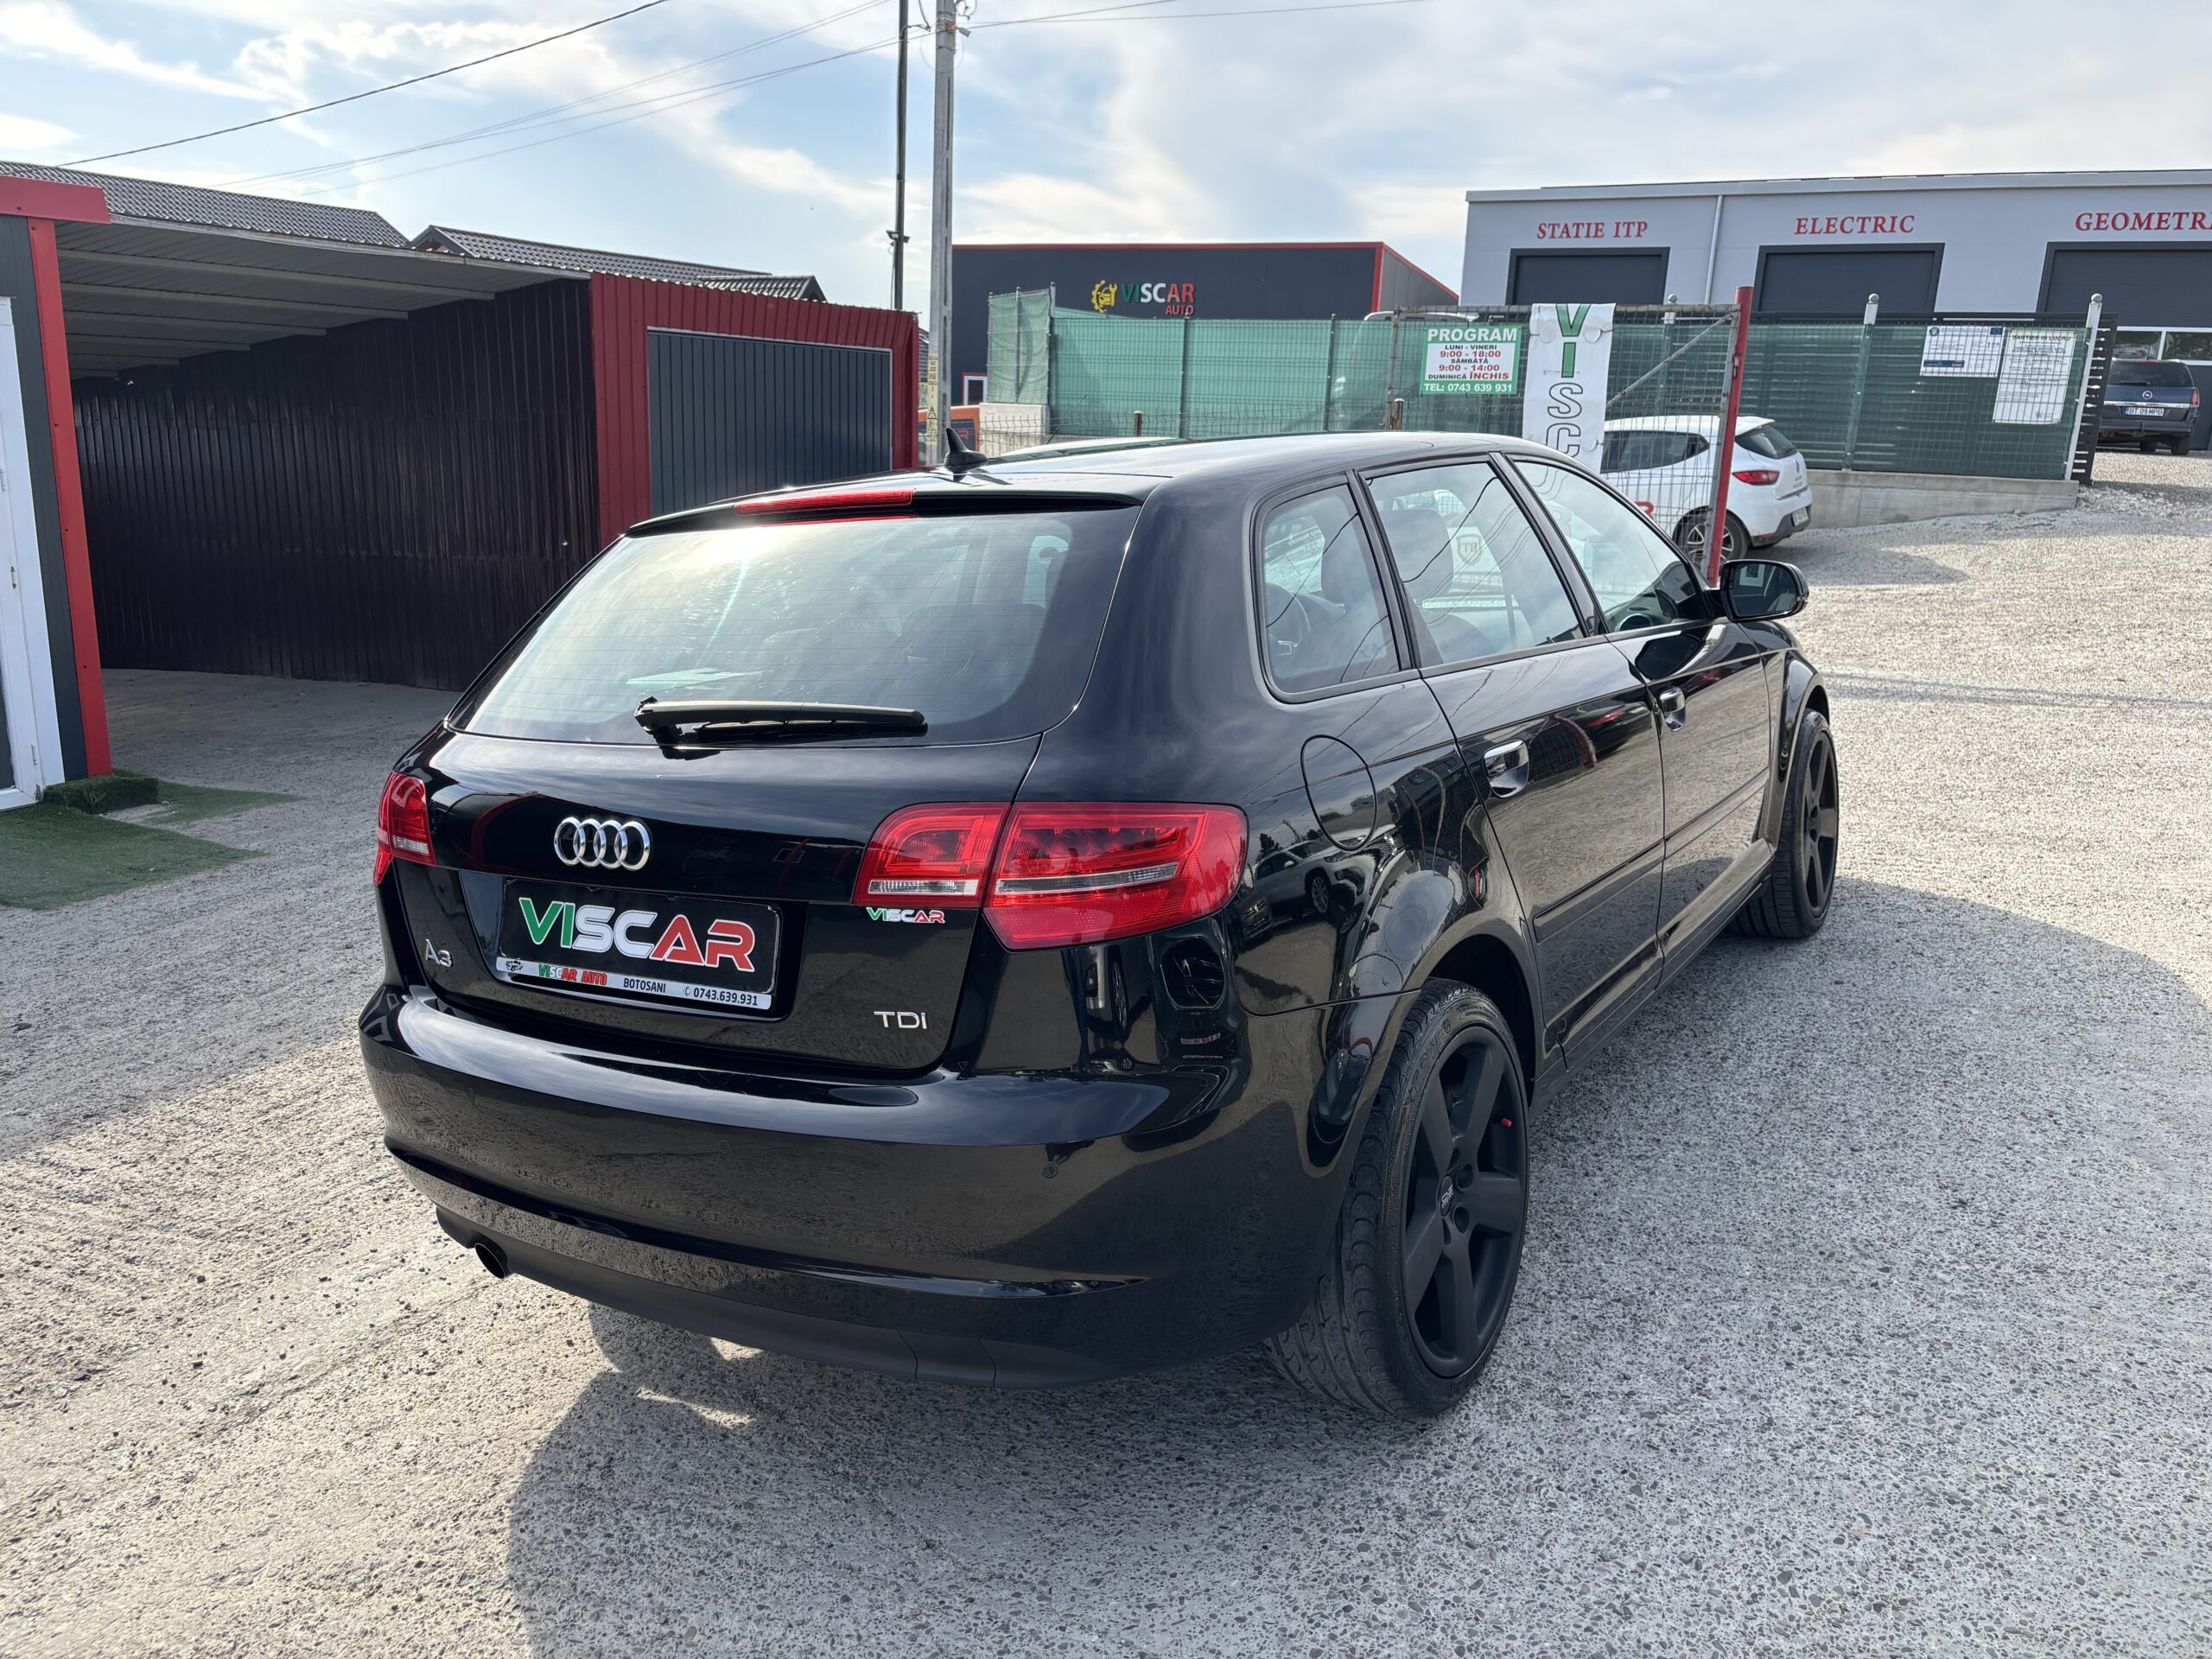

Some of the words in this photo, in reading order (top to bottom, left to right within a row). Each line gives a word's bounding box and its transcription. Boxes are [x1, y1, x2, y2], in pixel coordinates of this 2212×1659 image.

[1536, 222, 1605, 239] STATIE
[1612, 221, 1649, 238] ITP
[1794, 214, 1916, 235] ELECTRIC
[1122, 283, 1196, 303] VISCAR
[1165, 304, 1195, 315] AUTO
[1427, 327, 1517, 342] PROGRAM
[1424, 383, 1444, 391] TEL:
[1447, 383, 1471, 391] 0743
[1474, 383, 1492, 392] 639
[1495, 384, 1512, 392] 931
[866, 906, 946, 924] VISCAR
[518, 897, 756, 974] VISCAR
[425, 938, 452, 967] A3
[538, 963, 578, 982] VISCAR
[581, 970, 608, 986] AUTO
[623, 977, 666, 994] BOTOSANI
[693, 988, 758, 1007] 0743.639.931
